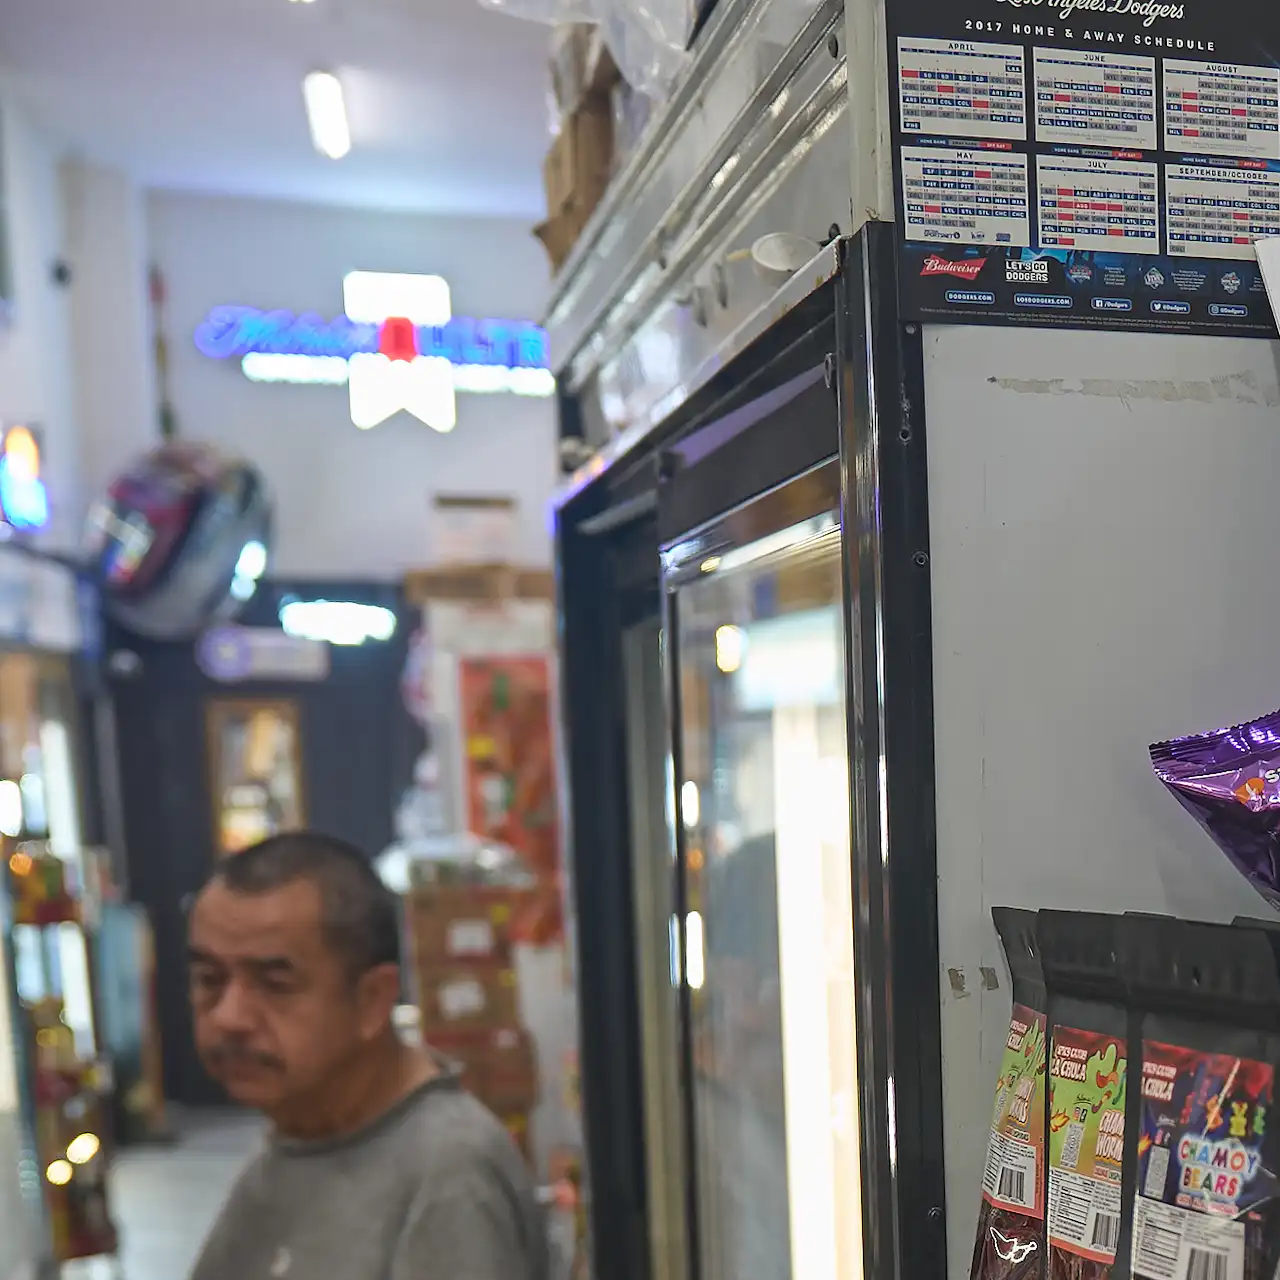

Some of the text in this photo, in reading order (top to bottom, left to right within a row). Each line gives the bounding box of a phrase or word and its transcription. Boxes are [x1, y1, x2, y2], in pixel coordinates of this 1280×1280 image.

[965, 20, 1215, 51] 2017 HOME & AWAY SCHEDULE
[948, 42, 975, 51] APRIL
[1084, 54, 1106, 62] JUNE
[1206, 65, 1238, 73] AUGUST
[1179, 168, 1268, 180] SEPTEMBER/OCTOBER
[923, 258, 981, 274] Budweiser
[1005, 260, 1045, 271] LET'S GO
[1005, 271, 1049, 282] DODGERS
[1180, 1140, 1257, 1174] CHAMOY
[1183, 1167, 1239, 1197] BEARS
